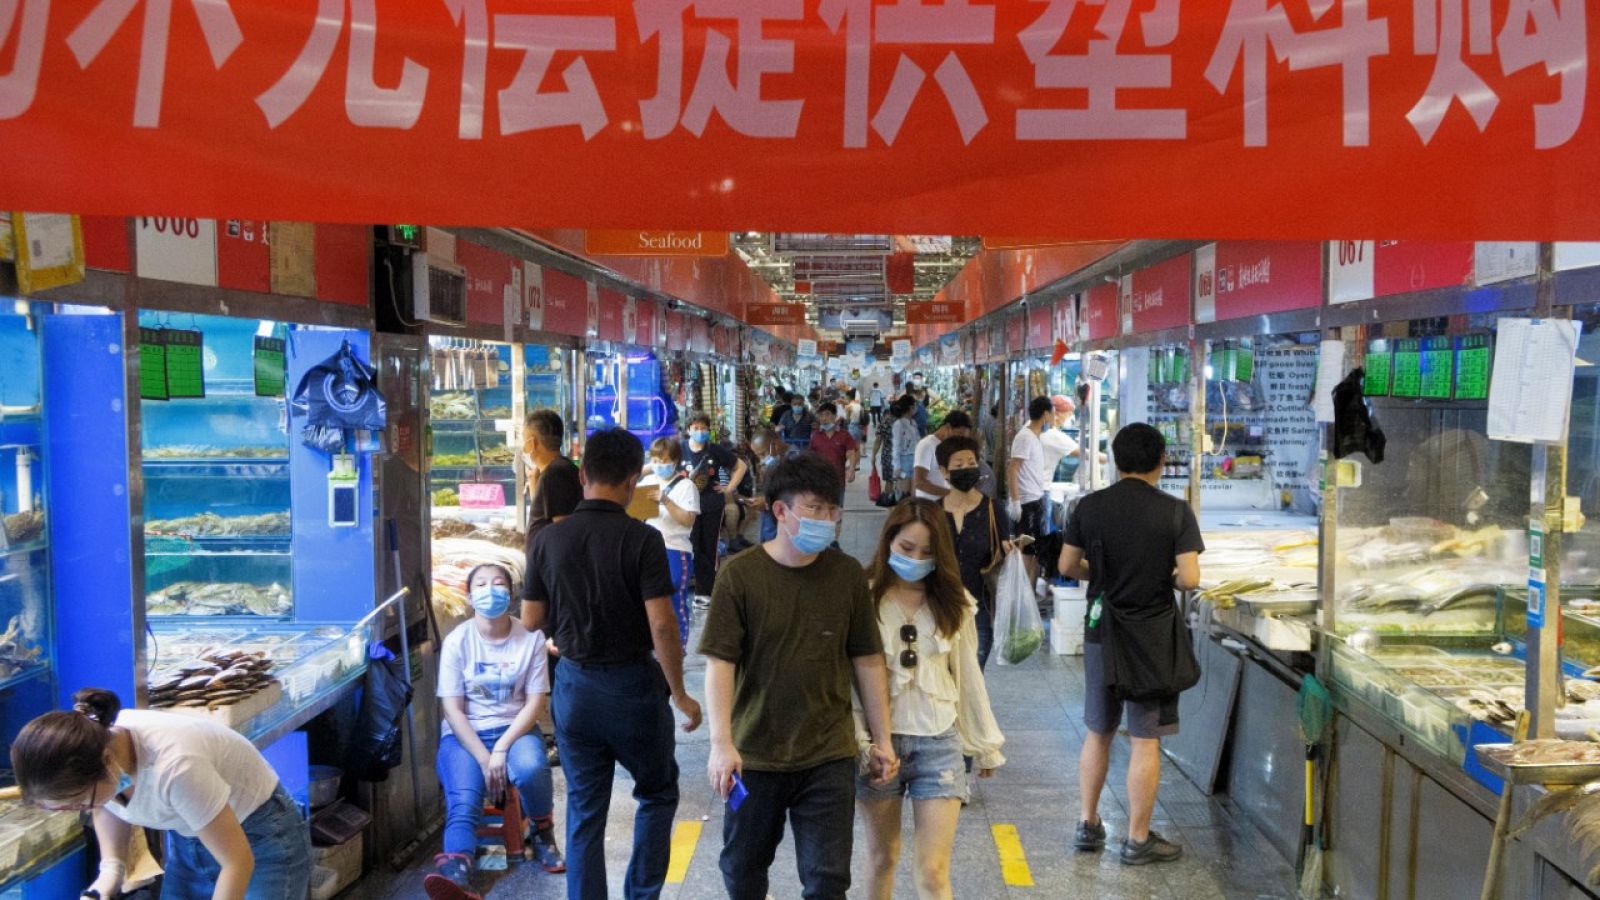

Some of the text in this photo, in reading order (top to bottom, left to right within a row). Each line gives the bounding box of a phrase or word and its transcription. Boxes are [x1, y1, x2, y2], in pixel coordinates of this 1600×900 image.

[638, 231, 703, 249] Seafood
[1338, 239, 1364, 266] 067
[1290, 416, 1305, 425] fish
